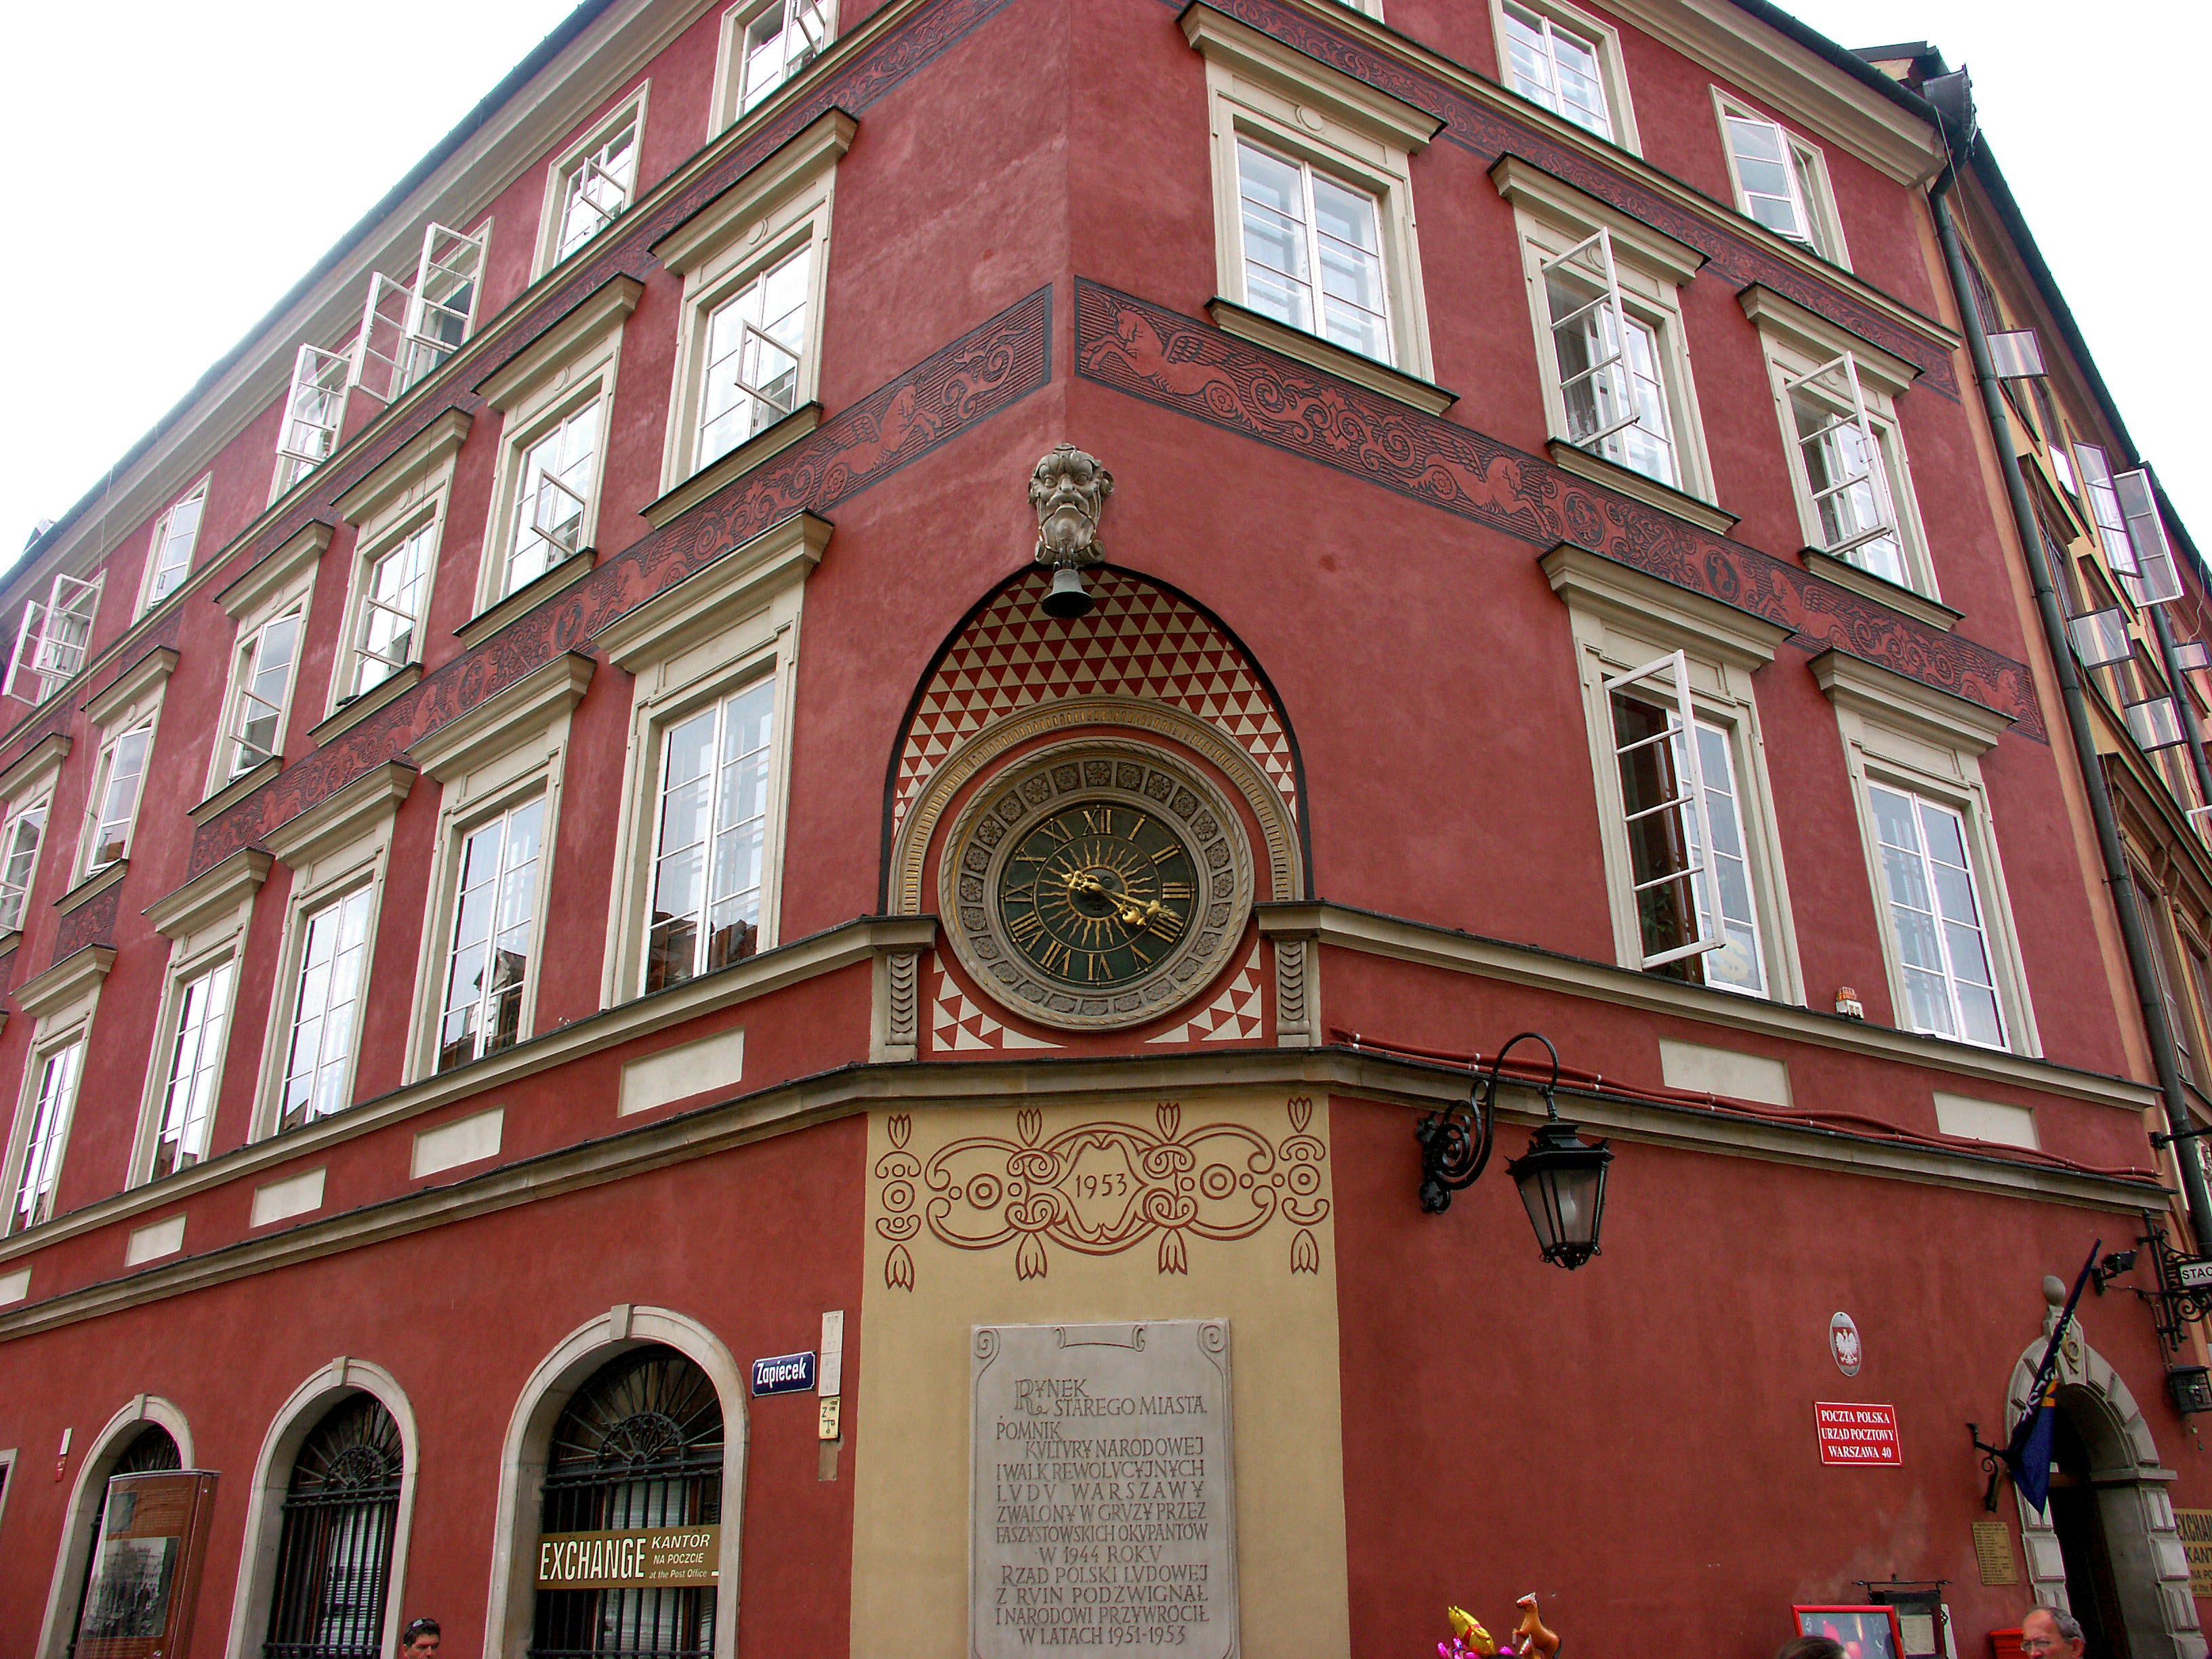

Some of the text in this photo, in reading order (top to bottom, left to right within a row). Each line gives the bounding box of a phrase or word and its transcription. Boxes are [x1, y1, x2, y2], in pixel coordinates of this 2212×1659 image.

[1076, 1172, 1127, 1199] 1953
[756, 1357, 806, 1388] Zapiecek
[1015, 1378, 1089, 1415] RYNEK
[1054, 1397, 1135, 1417] STAREGO
[1821, 1410, 1890, 1424] POCZTA POLSKA
[996, 1421, 1063, 1441] POMNIK
[1821, 1427, 1893, 1441] URZĄD POCZTOWY
[1095, 1436, 1204, 1458] NARODOWEJ
[1828, 1446, 1892, 1458] WARSZAWA 40
[996, 1464, 1001, 1481] I
[1003, 1462, 1050, 1482] WALK
[1071, 1480, 1205, 1502] WARSZAWY
[998, 1504, 1078, 1524] ZWALONY
[1079, 1504, 1096, 1523] W
[1156, 1501, 1206, 1521] PRZEZ
[651, 1534, 710, 1549] KANTOR
[996, 1525, 1115, 1544] FASZYSTOWSKICH
[539, 1538, 647, 1580] EXCHANGE
[653, 1553, 704, 1564] NA POCZCIE
[1038, 1546, 1058, 1565] W
[1063, 1545, 1099, 1566] 1944
[658, 1570, 669, 1578] the
[670, 1569, 686, 1578] Post
[687, 1568, 708, 1578] Office
[1055, 1565, 1118, 1584] POLSKI
[996, 1587, 1007, 1605] Z
[996, 1607, 1001, 1625] I
[1005, 1606, 1092, 1626] NARODOWI
[1019, 1624, 1187, 1647] W LATACH 1951-1953
